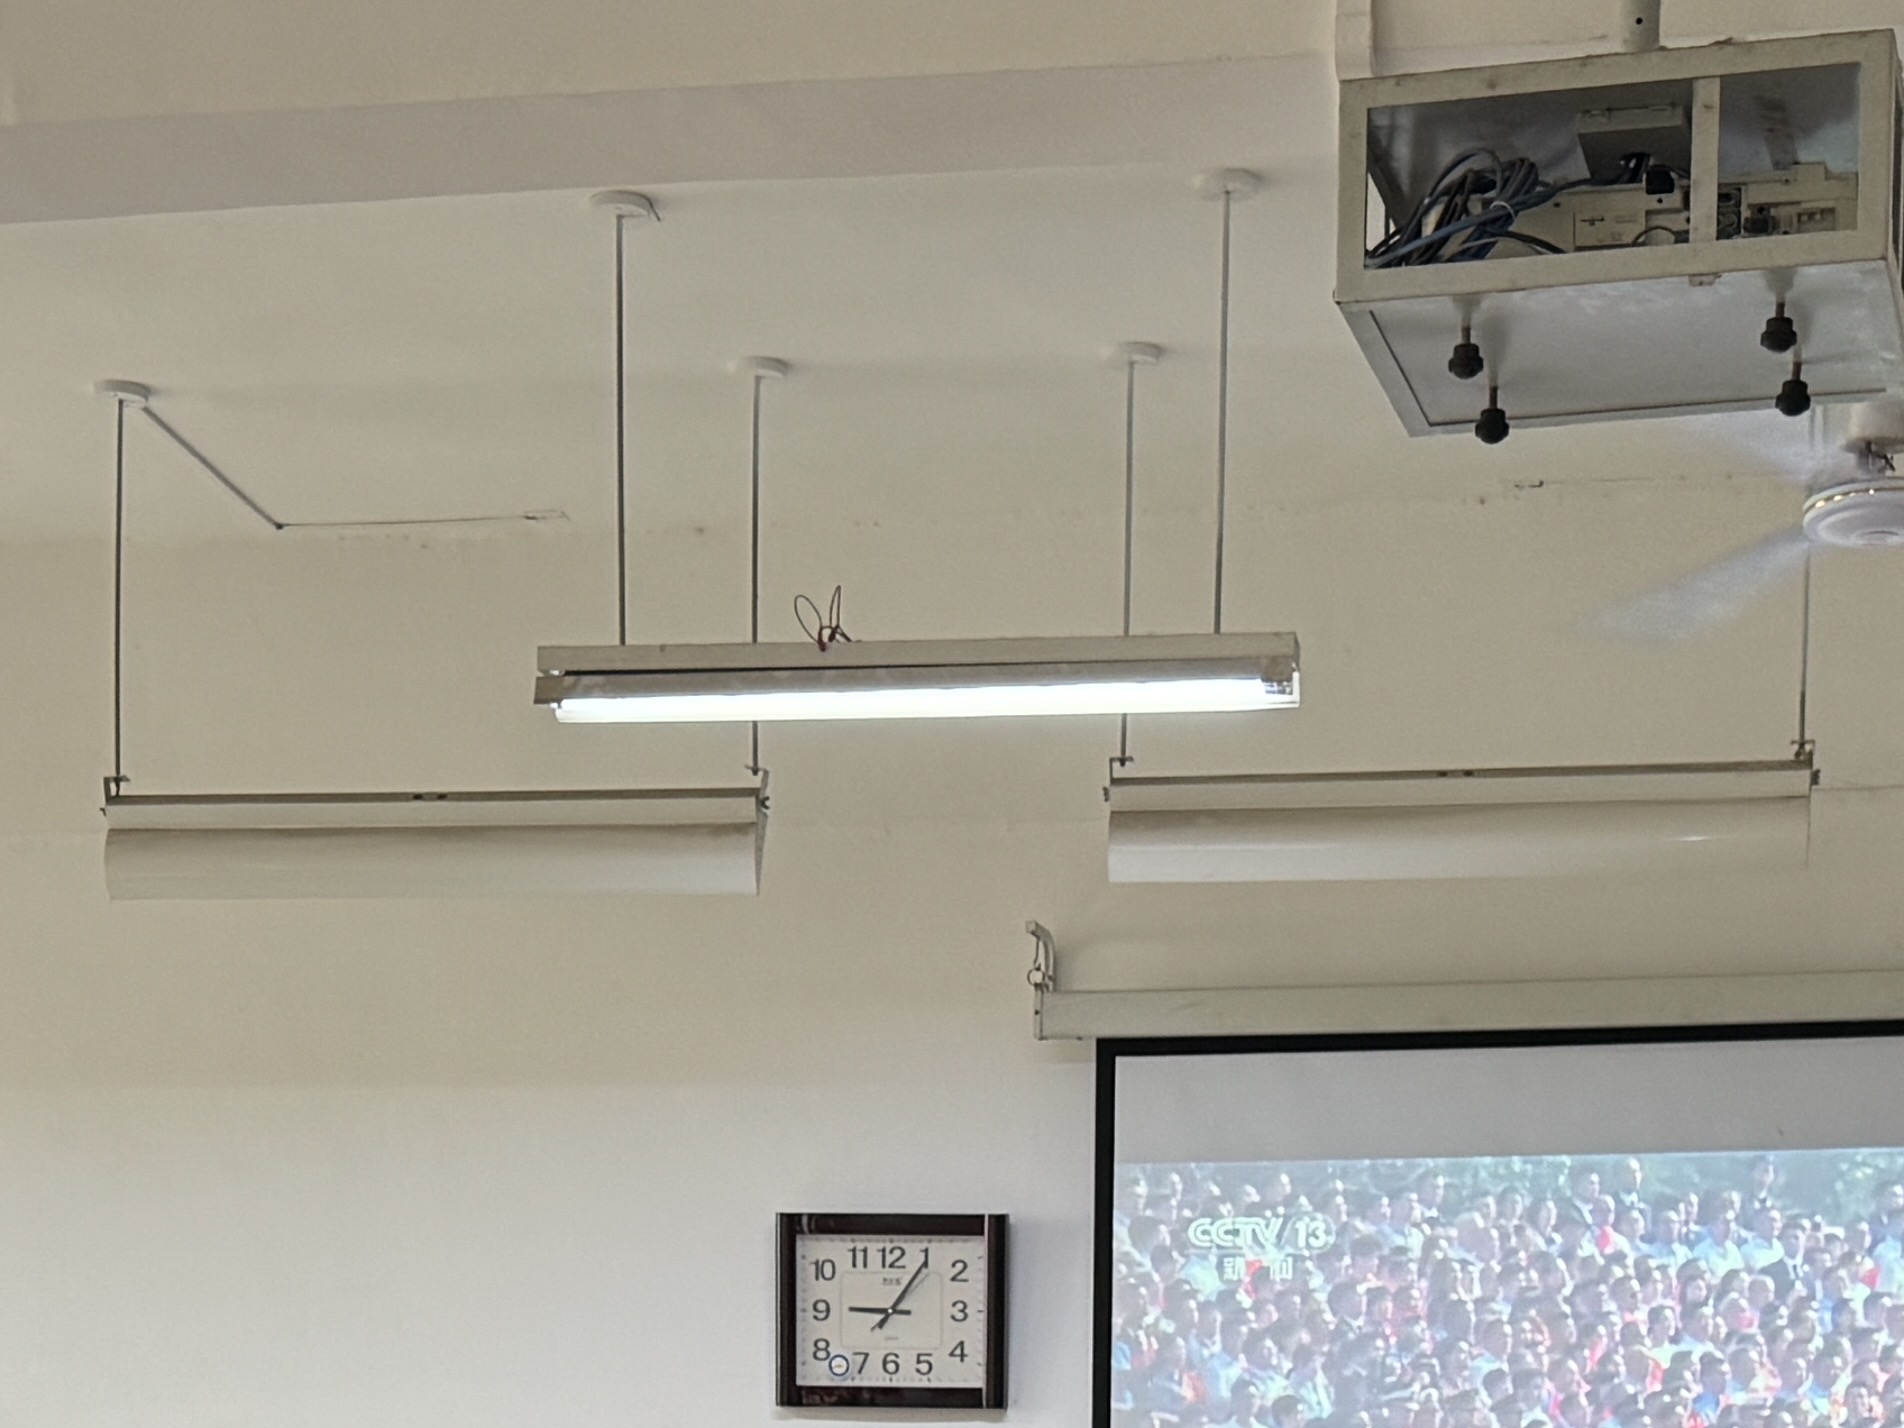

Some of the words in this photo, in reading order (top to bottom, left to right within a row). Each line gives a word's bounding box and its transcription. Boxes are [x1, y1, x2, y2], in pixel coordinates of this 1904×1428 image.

[1187, 1217, 1284, 1247] CCTV
[1295, 1219, 1327, 1248] 13
[847, 1246, 868, 1269] 11
[877, 1246, 907, 1269] 12
[919, 1246, 929, 1269] 1
[810, 1259, 836, 1281] 10
[949, 1259, 969, 1282] 2
[812, 1299, 831, 1321] 9
[950, 1300, 969, 1322] 3
[812, 1338, 831, 1361] 8
[948, 1340, 968, 1363] 4
[852, 1352, 870, 1374] 7
[881, 1352, 900, 1375] 6
[915, 1353, 933, 1375] 5
